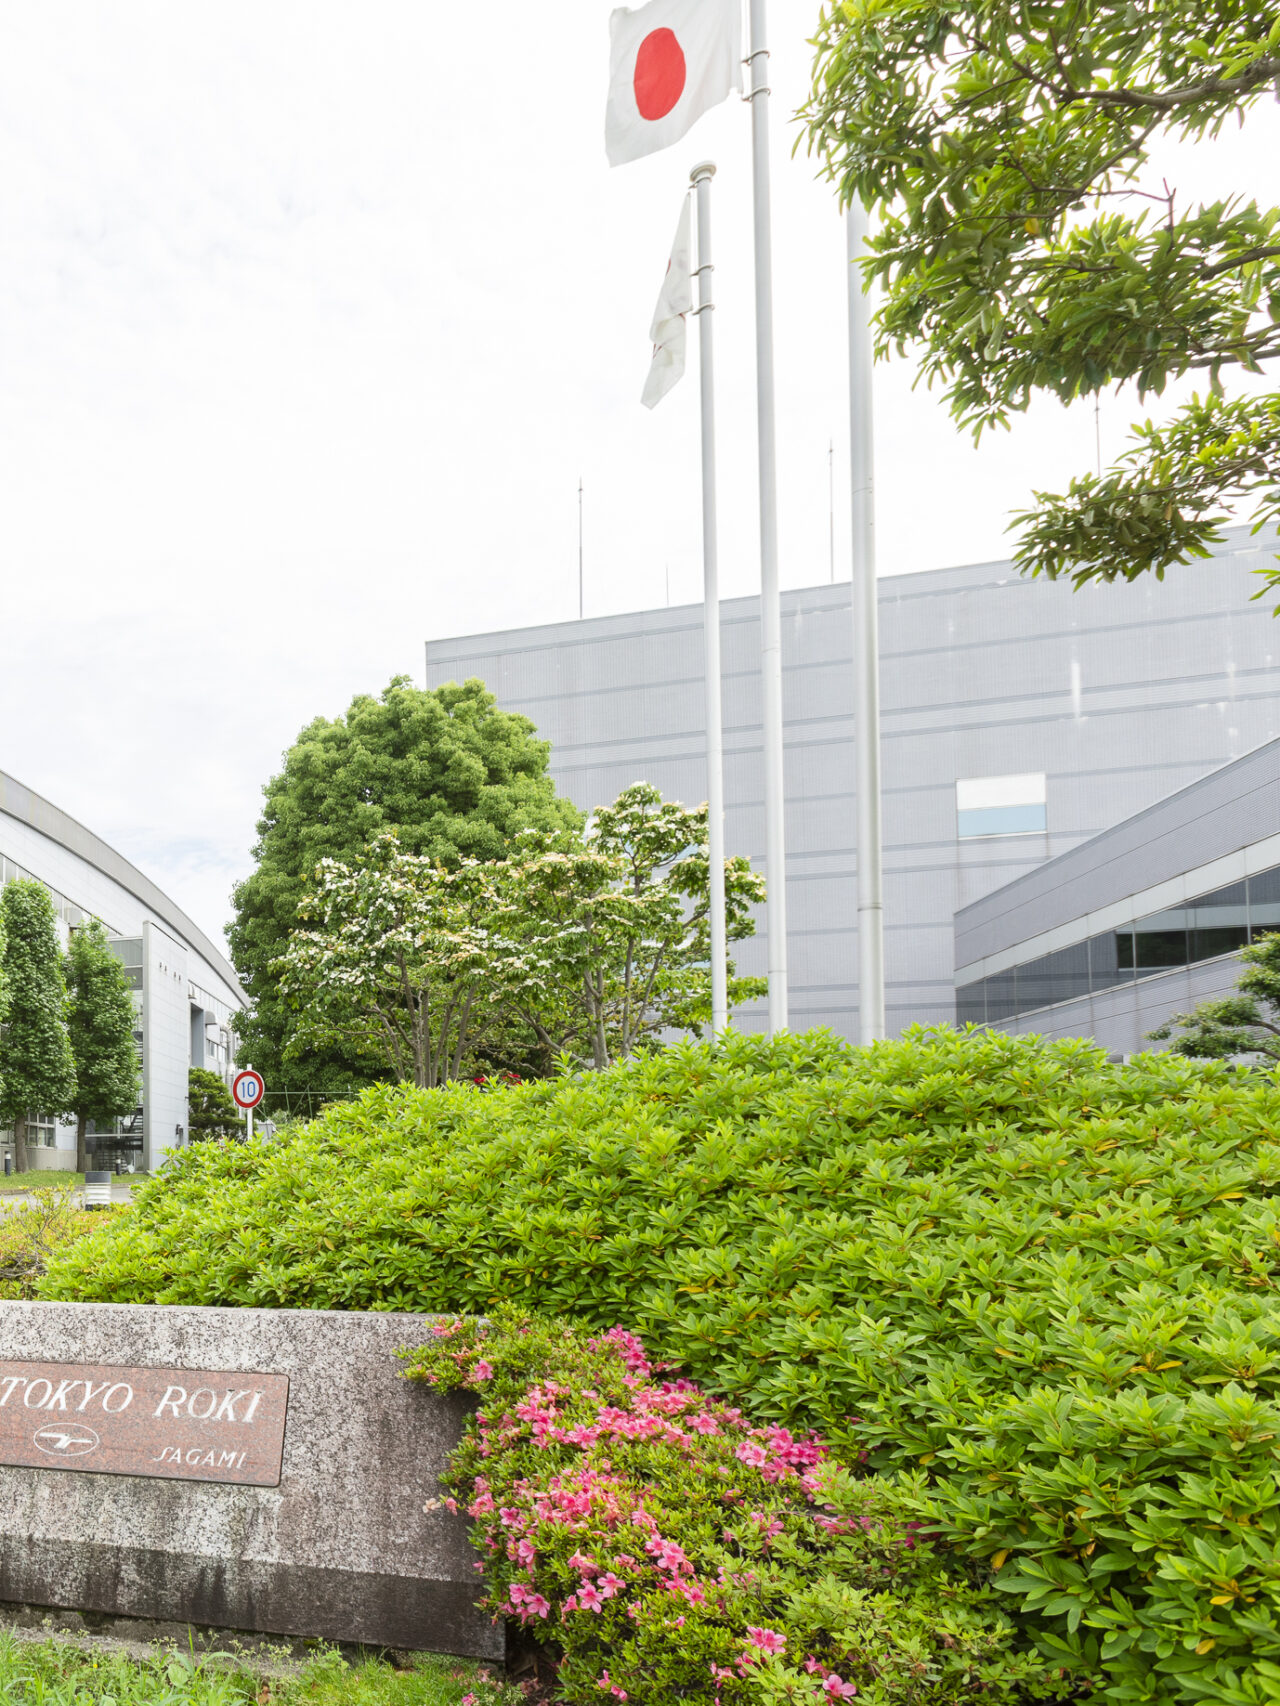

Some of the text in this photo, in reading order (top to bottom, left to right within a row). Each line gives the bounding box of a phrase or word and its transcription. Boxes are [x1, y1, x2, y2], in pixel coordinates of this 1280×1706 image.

[241, 1081, 256, 1099] 10
[151, 1385, 267, 1424] ROKI
[152, 1446, 247, 1470] SAGAMI
